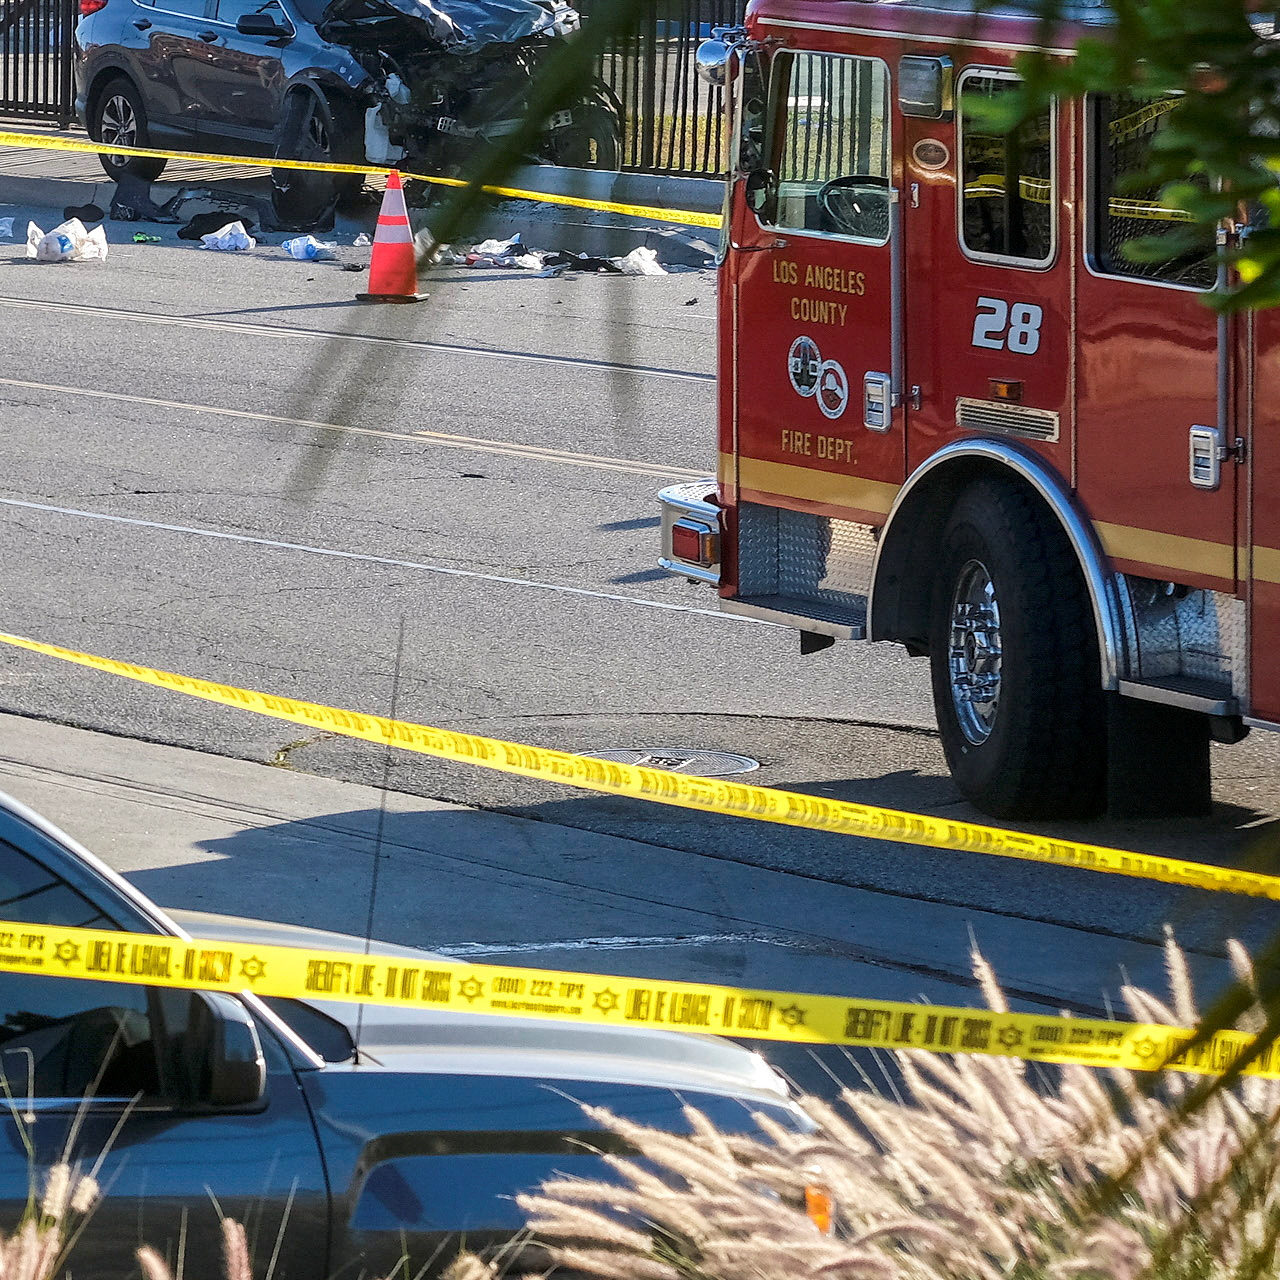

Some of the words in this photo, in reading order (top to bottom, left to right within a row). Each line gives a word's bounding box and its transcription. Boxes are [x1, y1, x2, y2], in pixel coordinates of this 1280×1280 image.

[772, 259, 799, 286] LOS
[804, 264, 866, 297] ANGELES
[790, 297, 848, 327] COUNTY
[970, 296, 1044, 356] 28
[781, 428, 812, 457] FIRE
[816, 434, 858, 466] DEPT.
